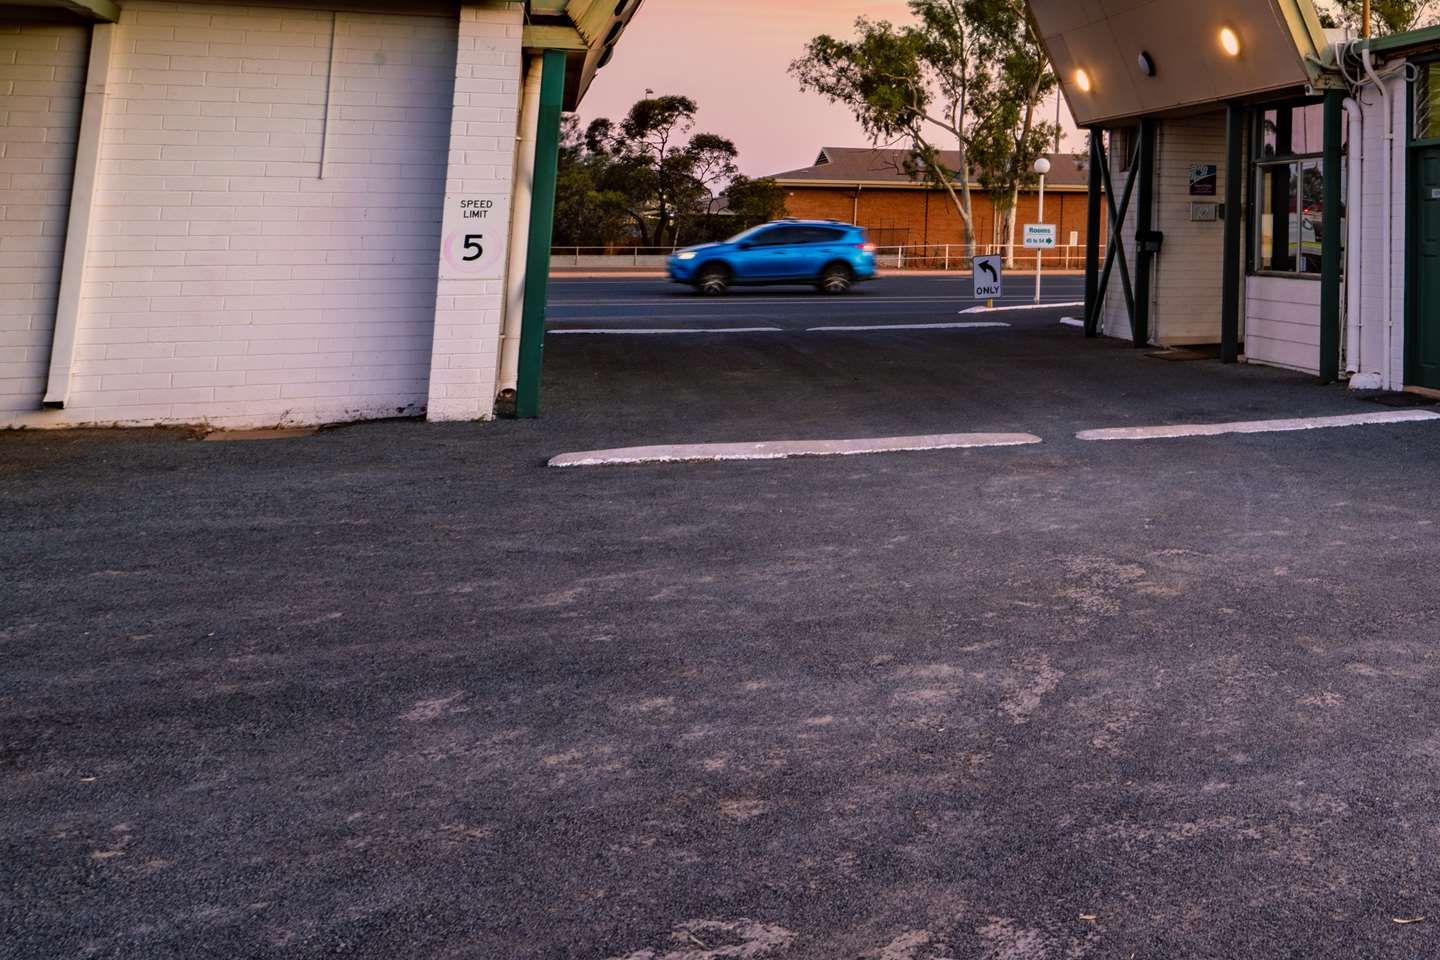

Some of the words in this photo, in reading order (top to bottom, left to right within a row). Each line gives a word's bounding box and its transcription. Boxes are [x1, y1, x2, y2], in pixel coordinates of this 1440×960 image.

[460, 200, 493, 208] SPEED
[463, 210, 488, 218] LIMIT
[462, 234, 484, 261] 5
[976, 286, 999, 295] ONLY
